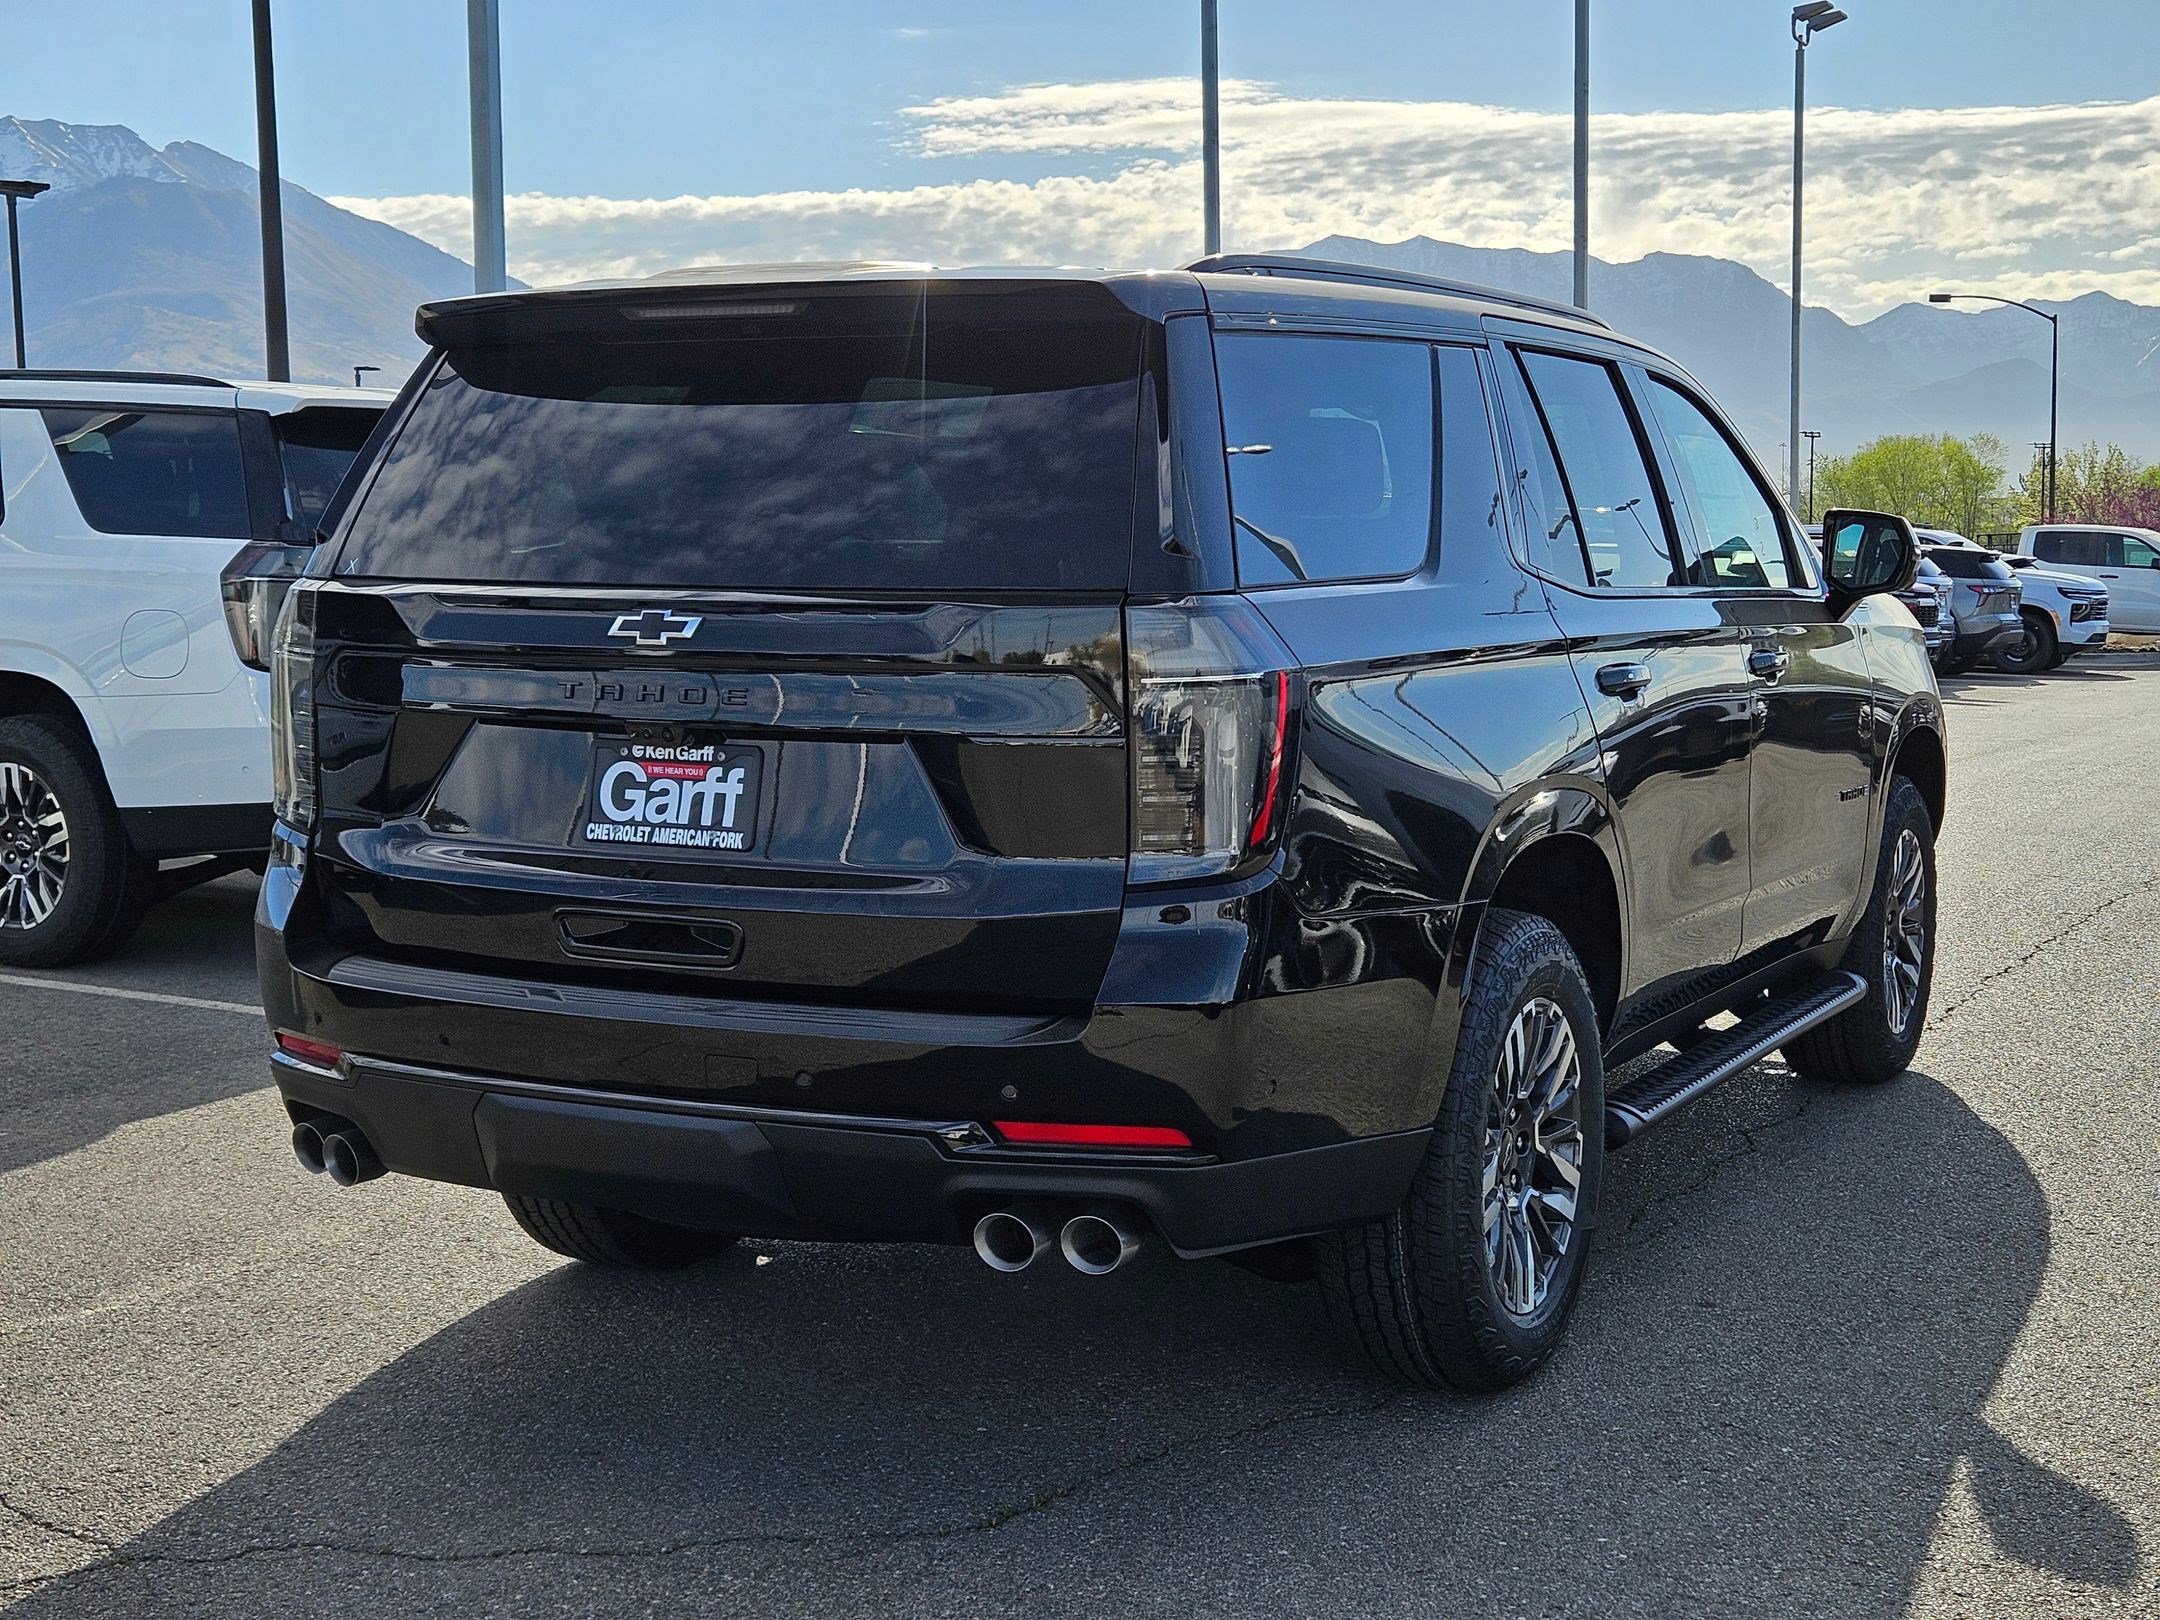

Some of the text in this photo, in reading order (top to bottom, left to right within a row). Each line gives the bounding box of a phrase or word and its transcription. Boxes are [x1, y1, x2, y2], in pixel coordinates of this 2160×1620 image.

[558, 681, 749, 706] TAHOE
[645, 745, 674, 760] Ken
[676, 746, 715, 762] Garff
[653, 766, 698, 776] WE HEAR YOU
[600, 760, 745, 828] Garff
[586, 822, 744, 849] CHEVROLET AMERICAN FORK
